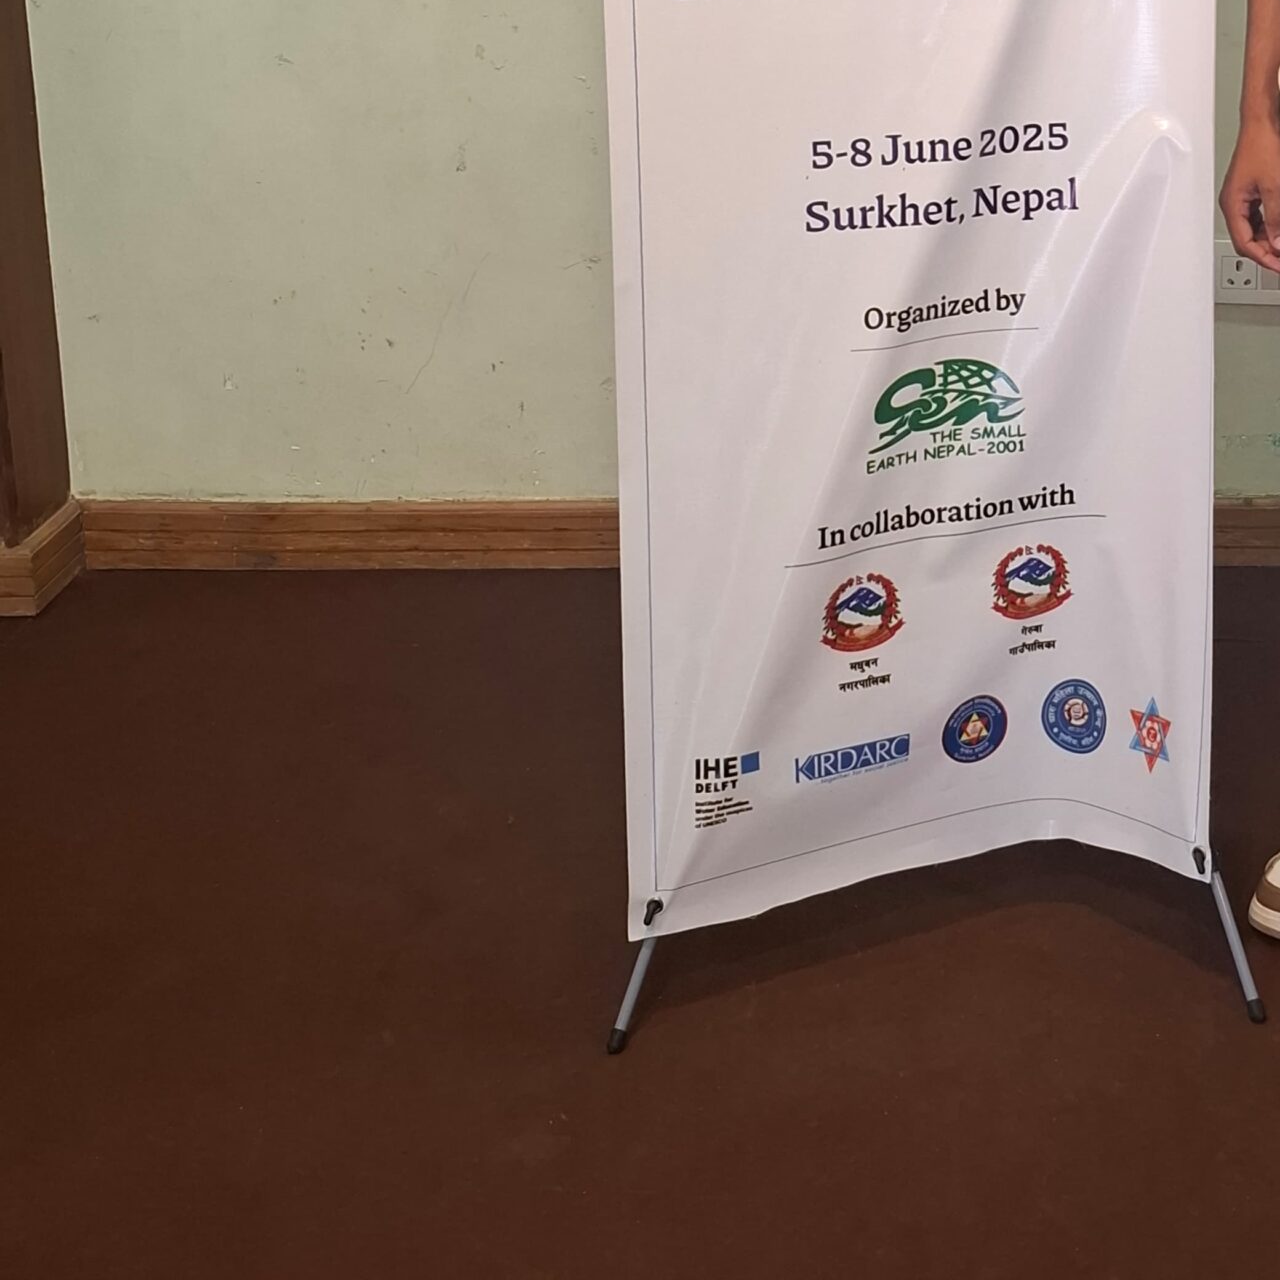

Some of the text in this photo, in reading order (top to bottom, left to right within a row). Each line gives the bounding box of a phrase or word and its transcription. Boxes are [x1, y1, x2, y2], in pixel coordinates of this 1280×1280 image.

[811, 122, 1070, 170] 5-8 June 2025
[805, 177, 1080, 233] Surkhet, Nepal
[863, 287, 1027, 334] Organized by
[866, 439, 1025, 475] EARTH NEPAL-2001
[929, 424, 1027, 444] THE SMALL
[817, 482, 1076, 550] In collaboration with
[694, 756, 739, 781] IHE
[795, 733, 910, 785] KIRDARC
[695, 779, 738, 794] DELFT
